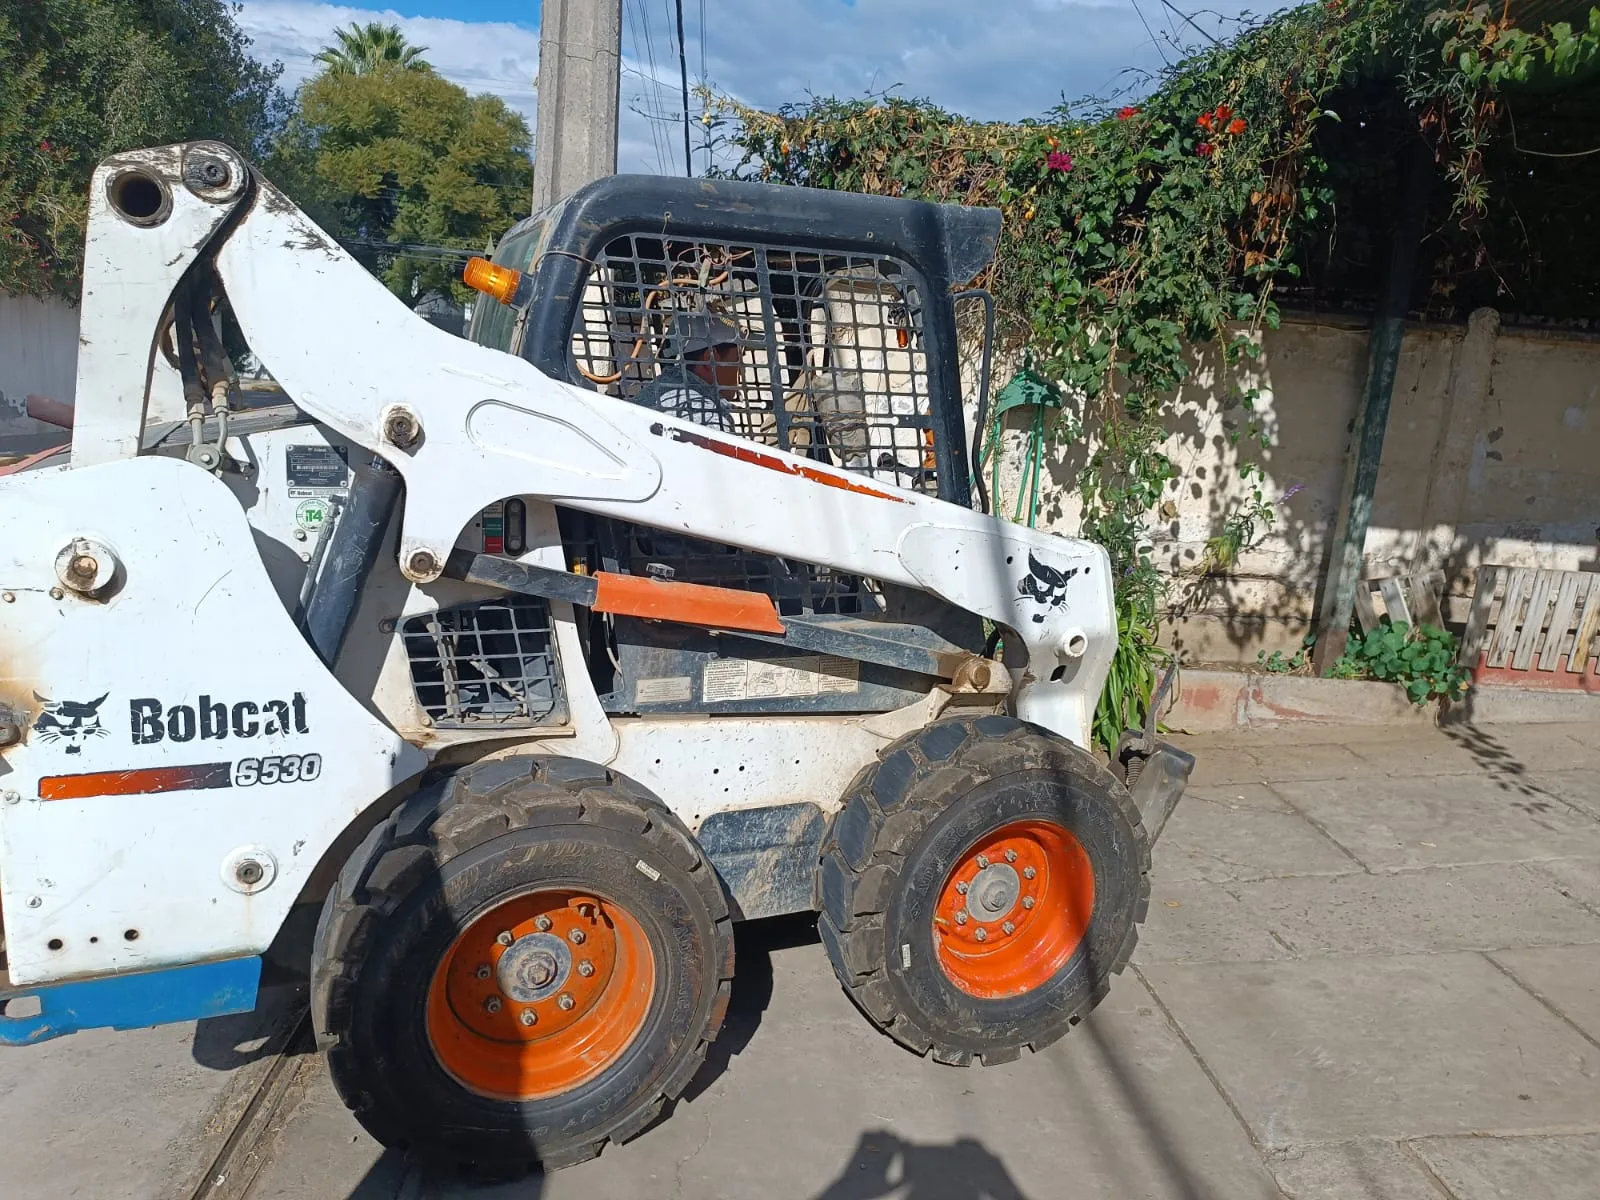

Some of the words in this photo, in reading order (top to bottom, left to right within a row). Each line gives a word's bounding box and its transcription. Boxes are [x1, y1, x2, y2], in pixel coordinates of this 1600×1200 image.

[305, 509, 324, 522] iT4
[129, 691, 310, 746] Bobcat
[235, 753, 322, 788] S530
